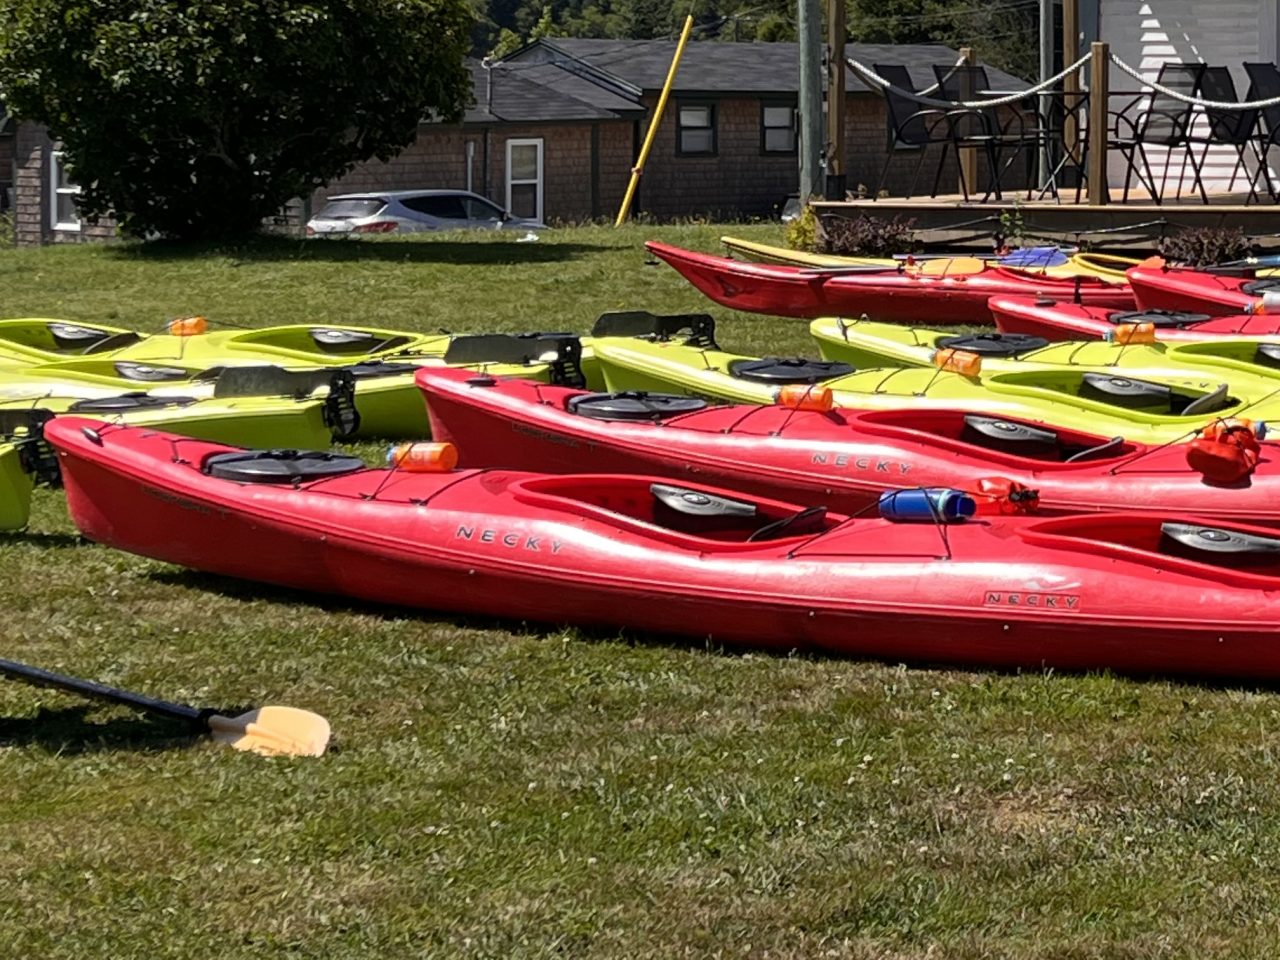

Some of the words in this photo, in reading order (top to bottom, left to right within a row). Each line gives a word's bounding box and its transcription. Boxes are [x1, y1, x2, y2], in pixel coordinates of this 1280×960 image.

[812, 453, 910, 474] NECKY
[456, 526, 562, 554] NECKY
[988, 594, 1077, 607] NECKY
